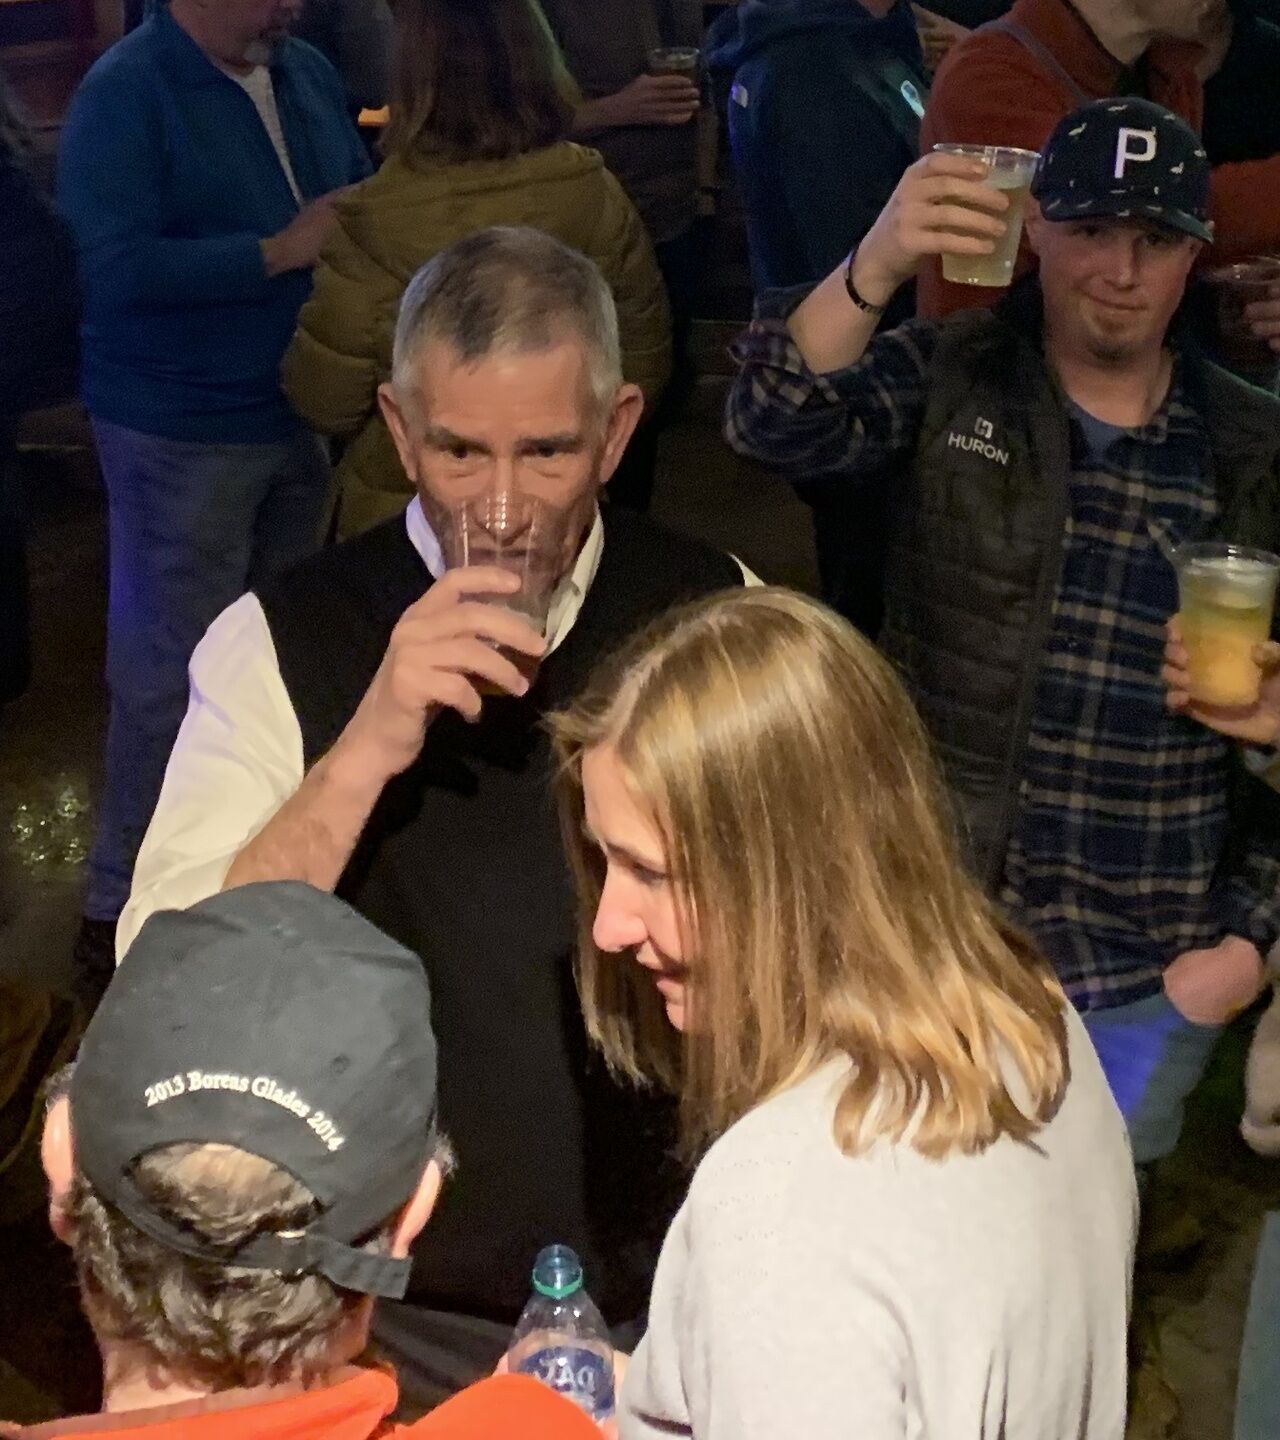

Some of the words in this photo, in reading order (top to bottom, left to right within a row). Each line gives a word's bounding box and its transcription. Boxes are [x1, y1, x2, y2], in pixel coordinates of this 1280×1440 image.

[1114, 127, 1158, 179] P
[947, 431, 1010, 466] HURON
[144, 1071, 185, 1107] 2013
[251, 1076, 311, 1119] Glades
[306, 1110, 346, 1153] 2014
